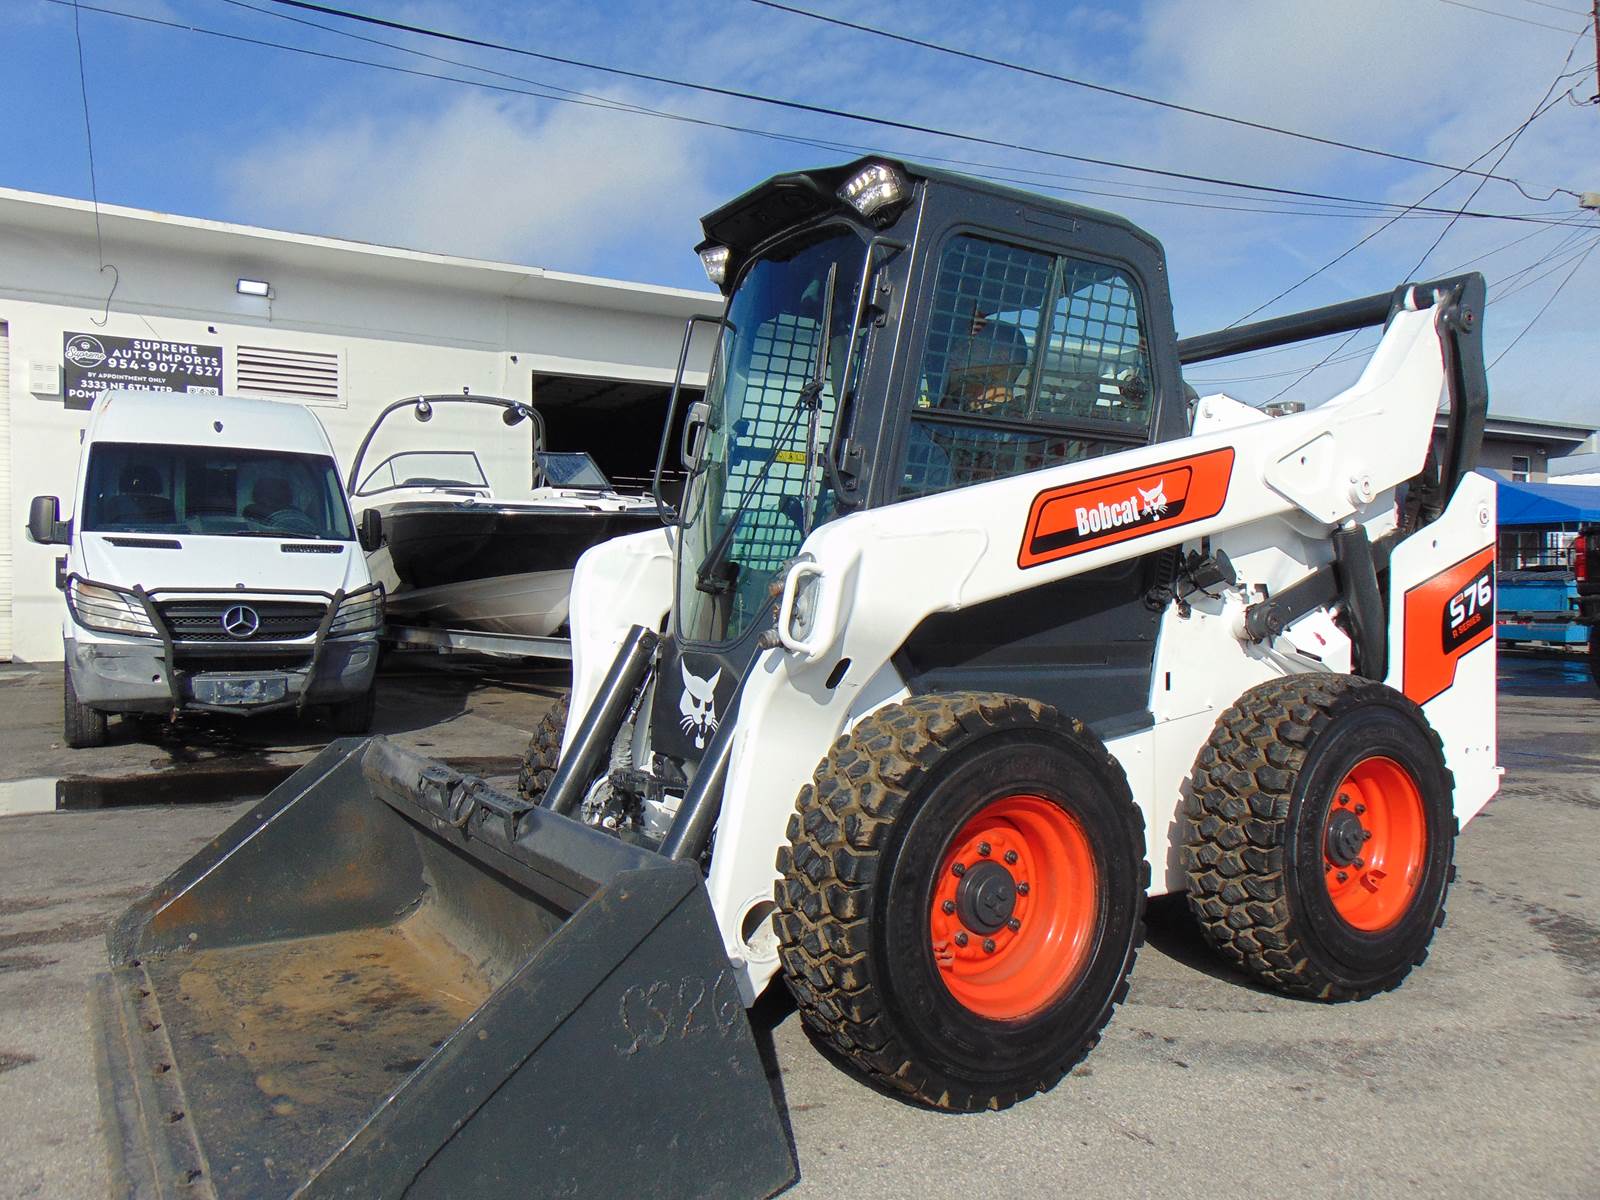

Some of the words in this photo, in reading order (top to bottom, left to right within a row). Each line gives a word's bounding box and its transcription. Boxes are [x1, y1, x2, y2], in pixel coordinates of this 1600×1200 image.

[65, 342, 107, 361] Supreme
[134, 340, 198, 355] SUPREME
[108, 358, 222, 377] 954-907-7527
[112, 349, 152, 360] AUTO
[157, 354, 219, 367] IMPORTS
[80, 379, 107, 389] 3333
[110, 382, 125, 390] NE
[127, 383, 150, 392] 6TH
[98, 372, 147, 382] APPOINTMENT
[1074, 495, 1141, 537] Bobcat
[1449, 575, 1491, 629] S76
[1452, 629, 1459, 639] R
[1458, 613, 1482, 635] SERIES
